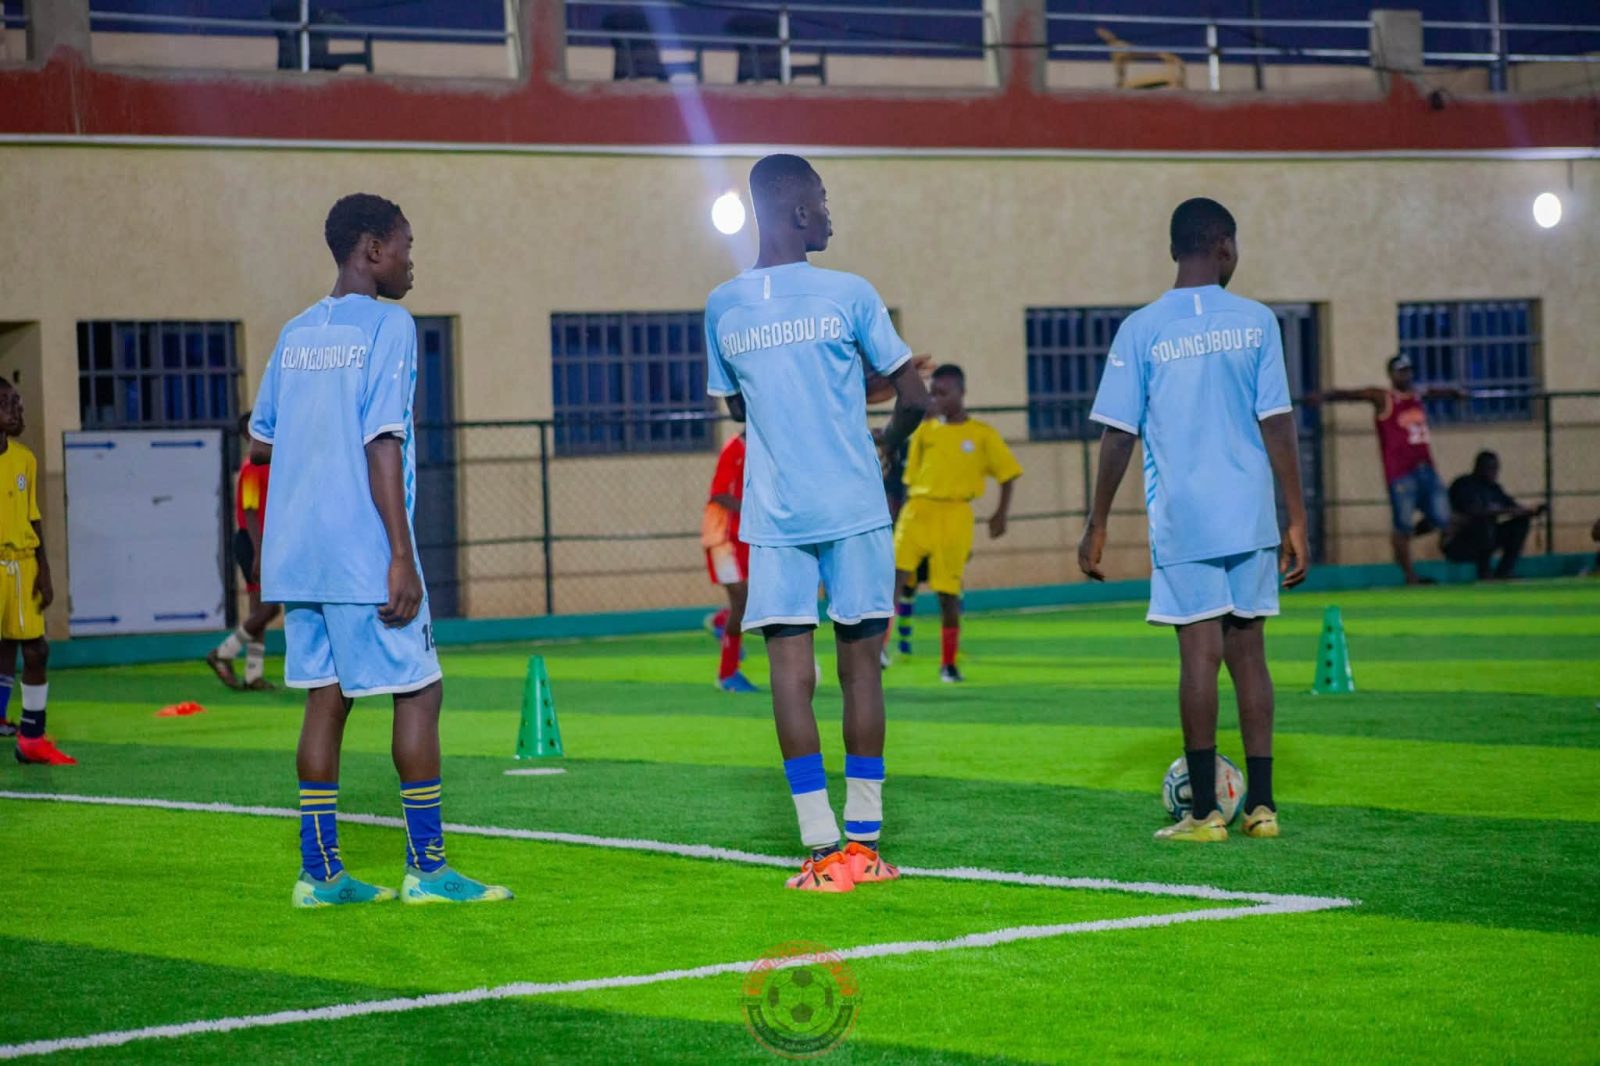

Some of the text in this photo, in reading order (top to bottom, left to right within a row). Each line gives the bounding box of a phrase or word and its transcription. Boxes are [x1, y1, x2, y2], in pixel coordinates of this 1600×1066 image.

[819, 316, 841, 340] FC
[1244, 327, 1263, 349] FC
[346, 344, 367, 370] FC
